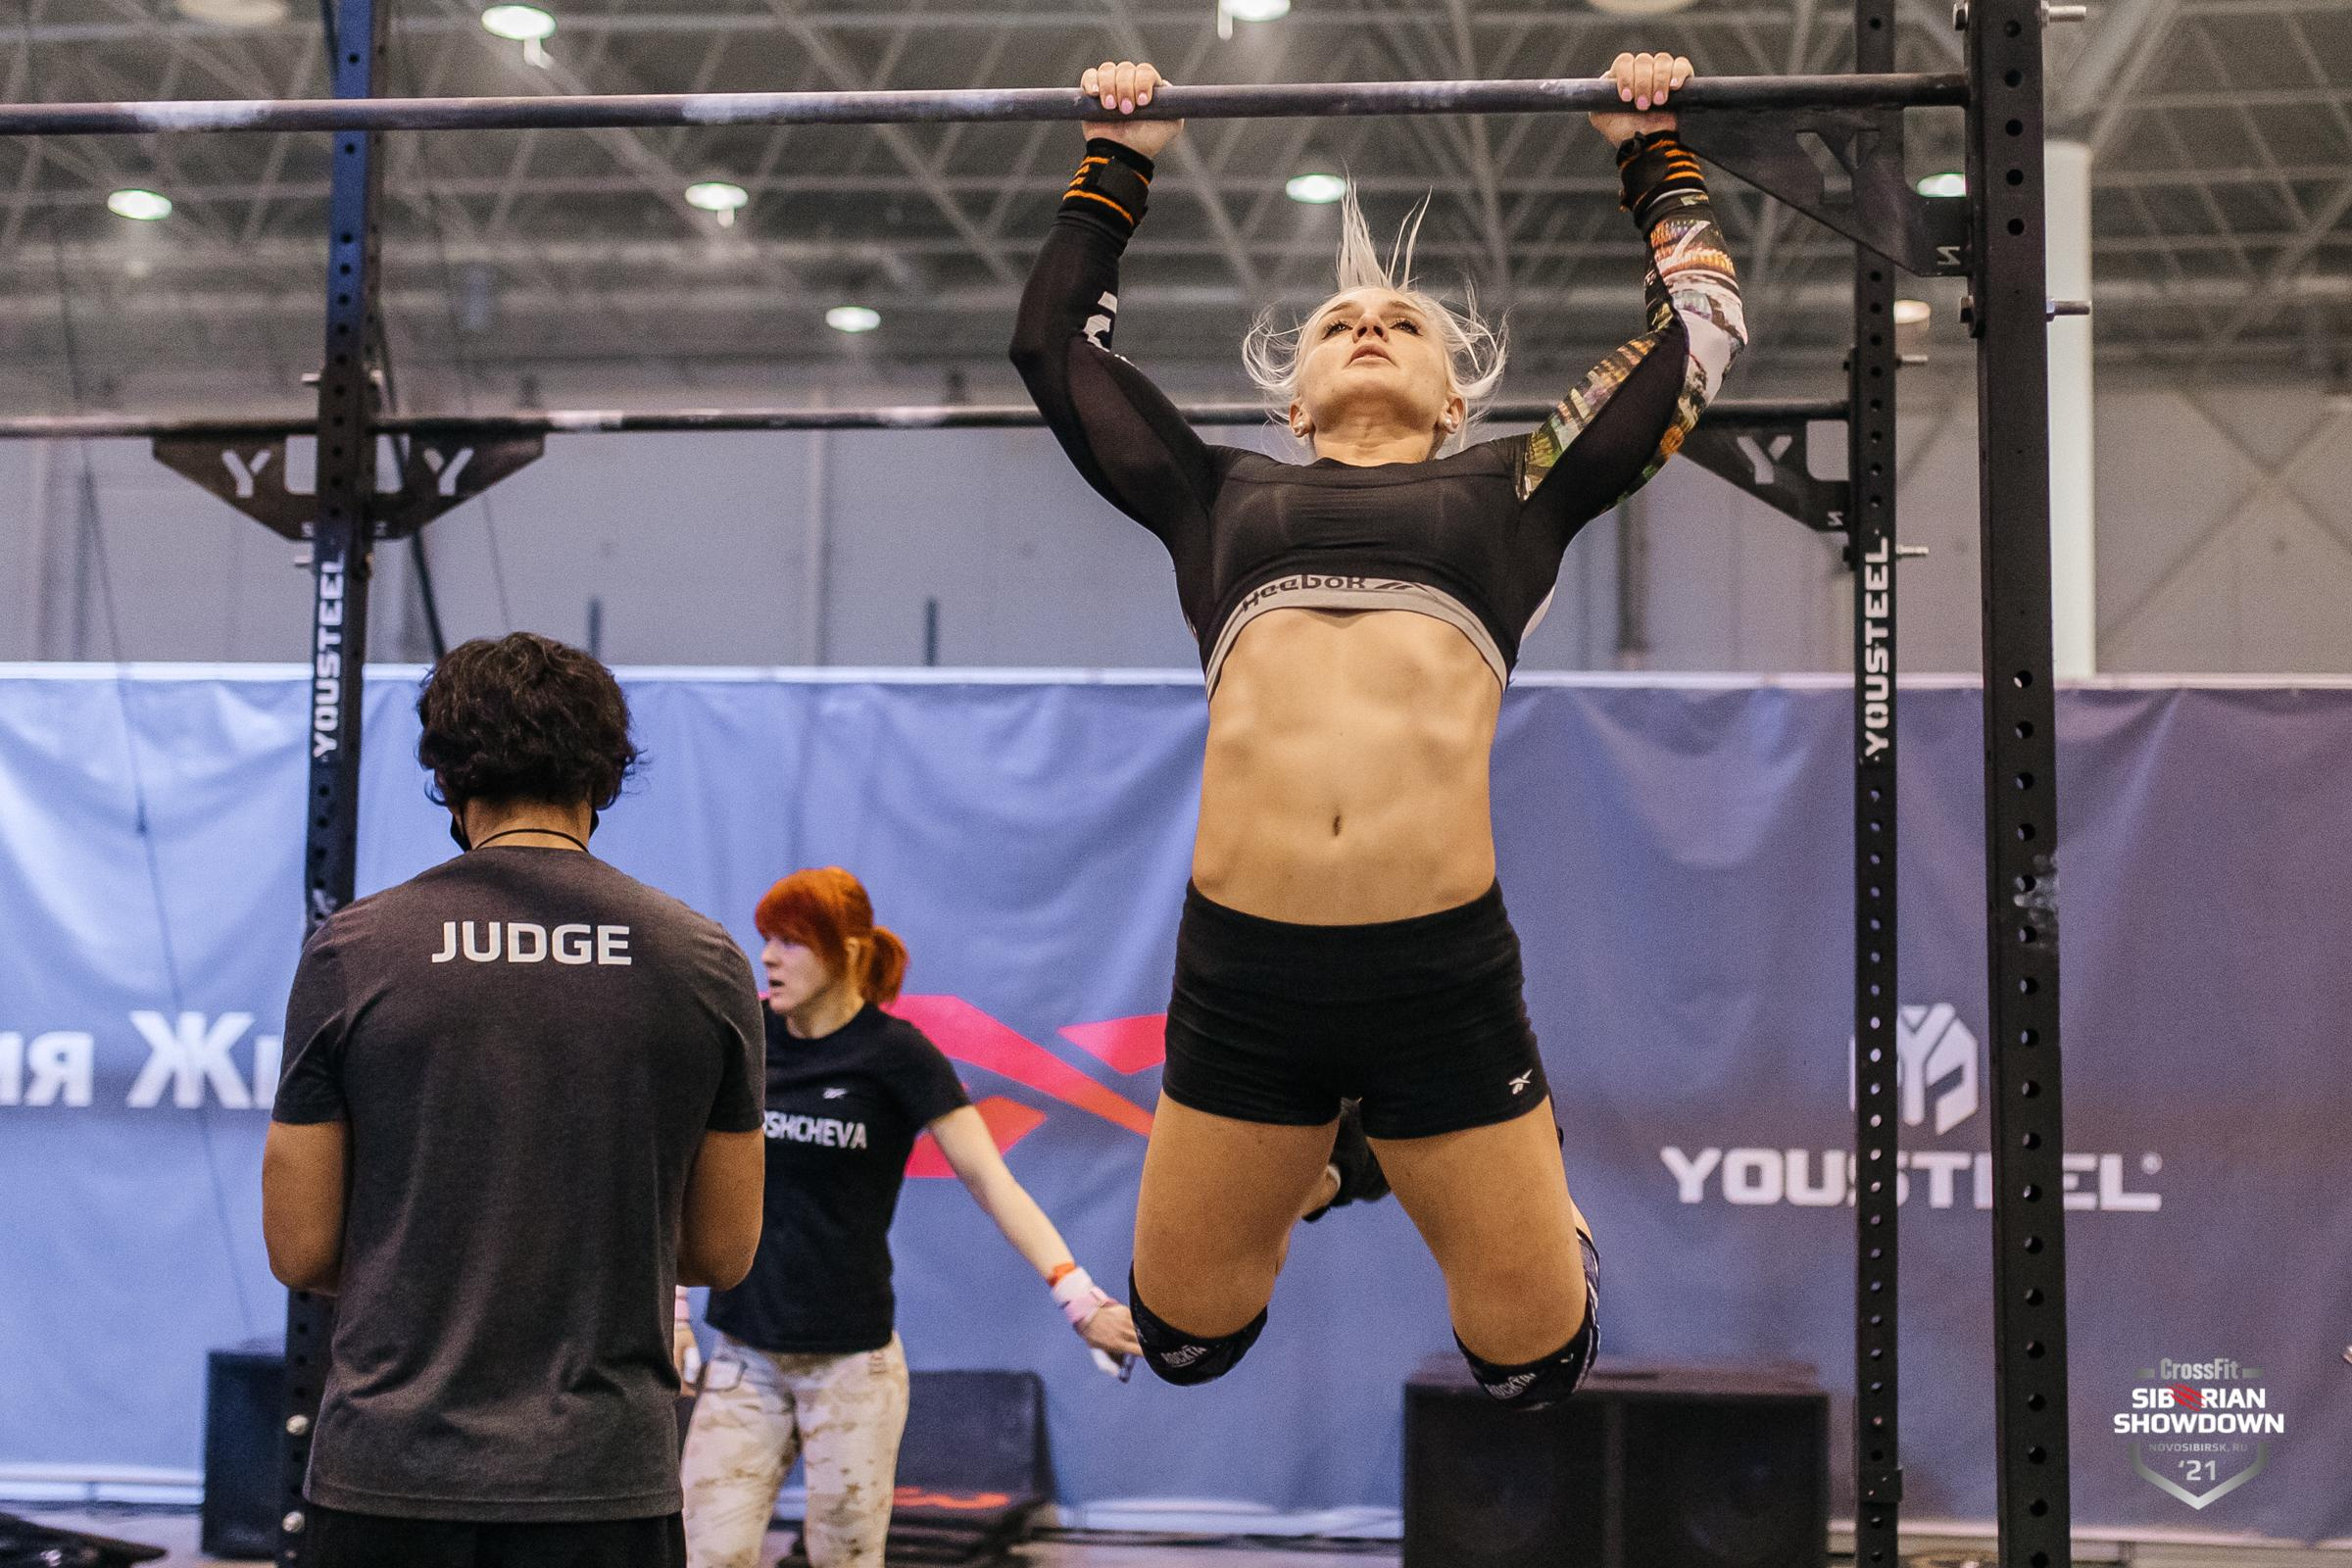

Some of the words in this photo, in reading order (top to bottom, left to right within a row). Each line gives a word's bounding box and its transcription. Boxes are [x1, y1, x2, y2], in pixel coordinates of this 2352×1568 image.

[313, 552, 344, 759] YOUSTEEL
[1864, 536, 1889, 757] YOUSTEEL
[431, 920, 632, 966] JUDGE
[762, 1109, 867, 1150] SHCHEVA
